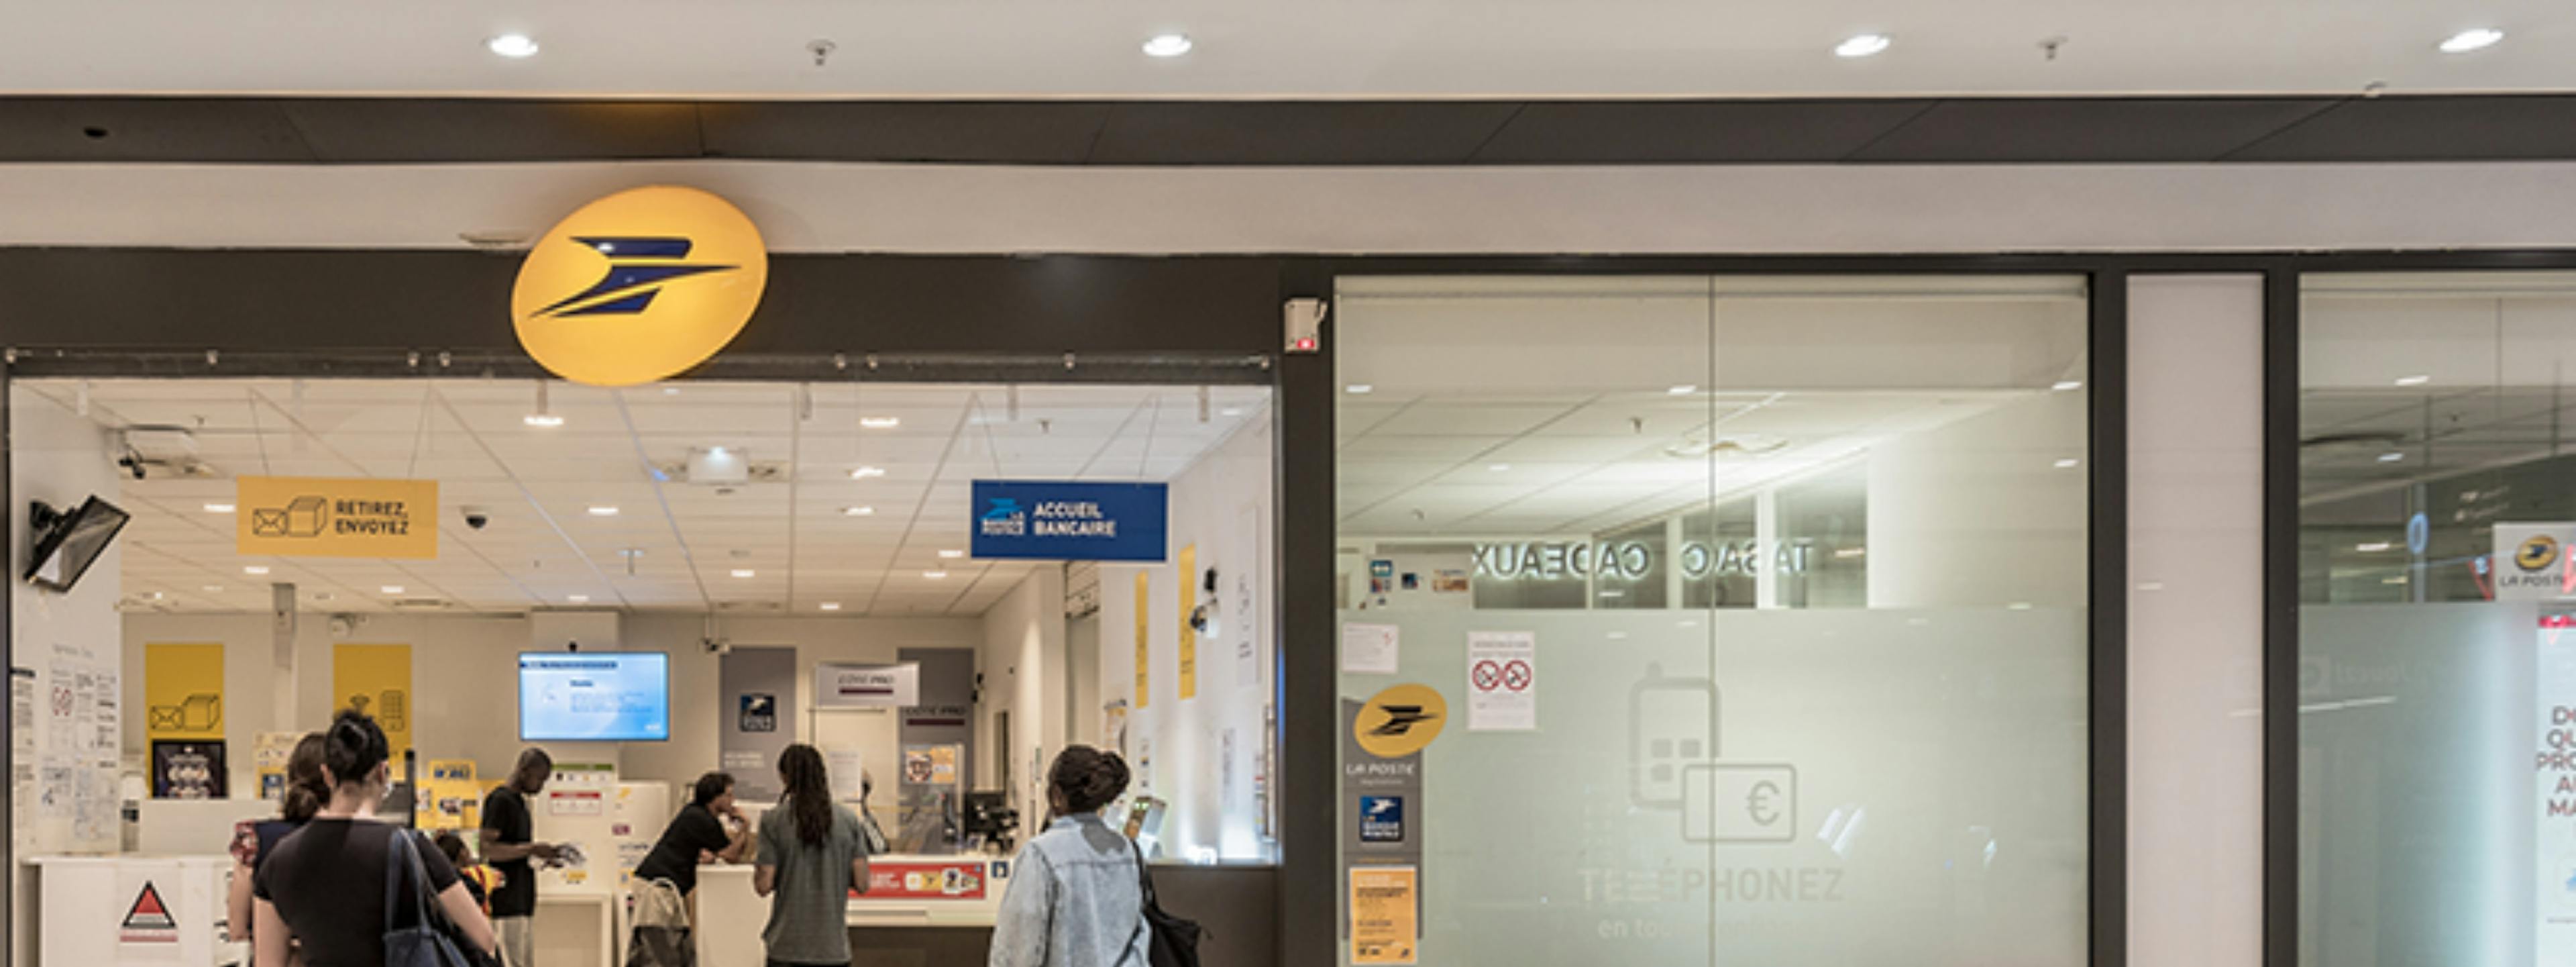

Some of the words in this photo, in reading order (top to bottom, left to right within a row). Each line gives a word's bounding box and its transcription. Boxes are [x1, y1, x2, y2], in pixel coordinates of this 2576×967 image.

[1033, 502, 1102, 519] ACCUEIL
[336, 519, 408, 535] ENVOYEZ
[1034, 521, 1116, 536] BANCAIRE
[2522, 575, 2565, 587] POST
[2552, 706, 2576, 725] D
[1346, 764, 1366, 775] LA
[1368, 763, 1414, 776] POSTE
[2555, 776, 2576, 795] A
[2547, 799, 2576, 817] M
